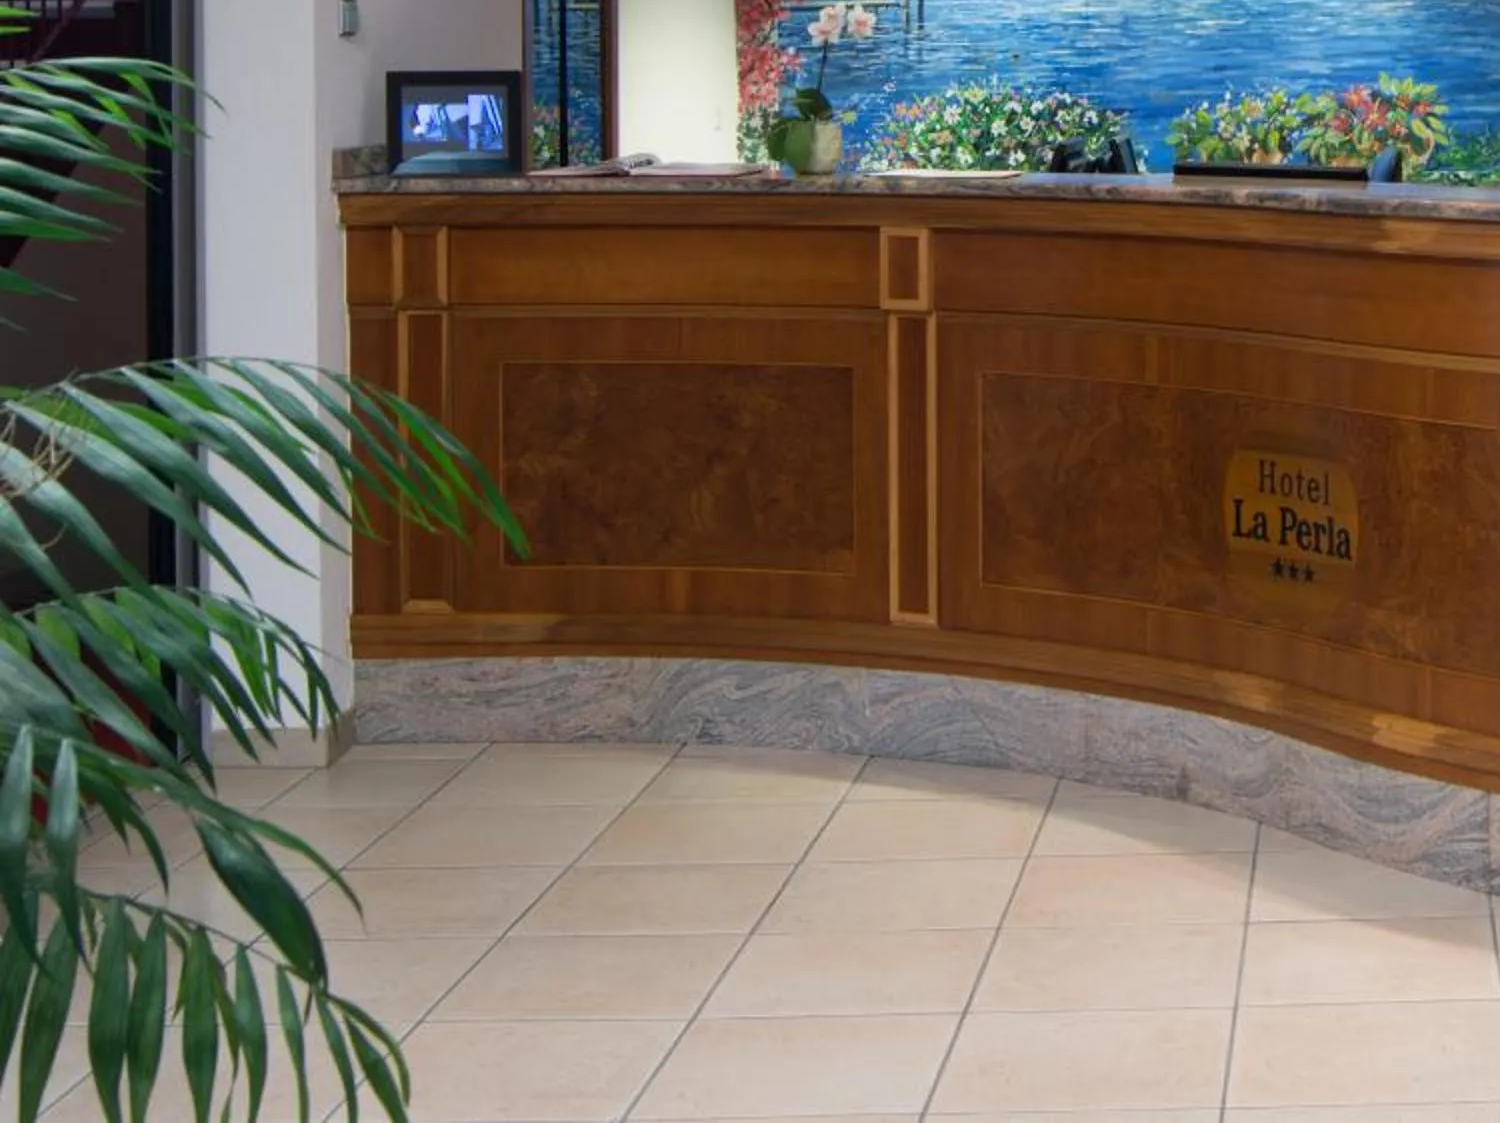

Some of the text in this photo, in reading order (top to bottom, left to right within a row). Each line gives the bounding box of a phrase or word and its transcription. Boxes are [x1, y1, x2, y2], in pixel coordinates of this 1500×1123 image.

[1258, 459, 1330, 506] Hotel
[1232, 498, 1352, 561] La Perla
